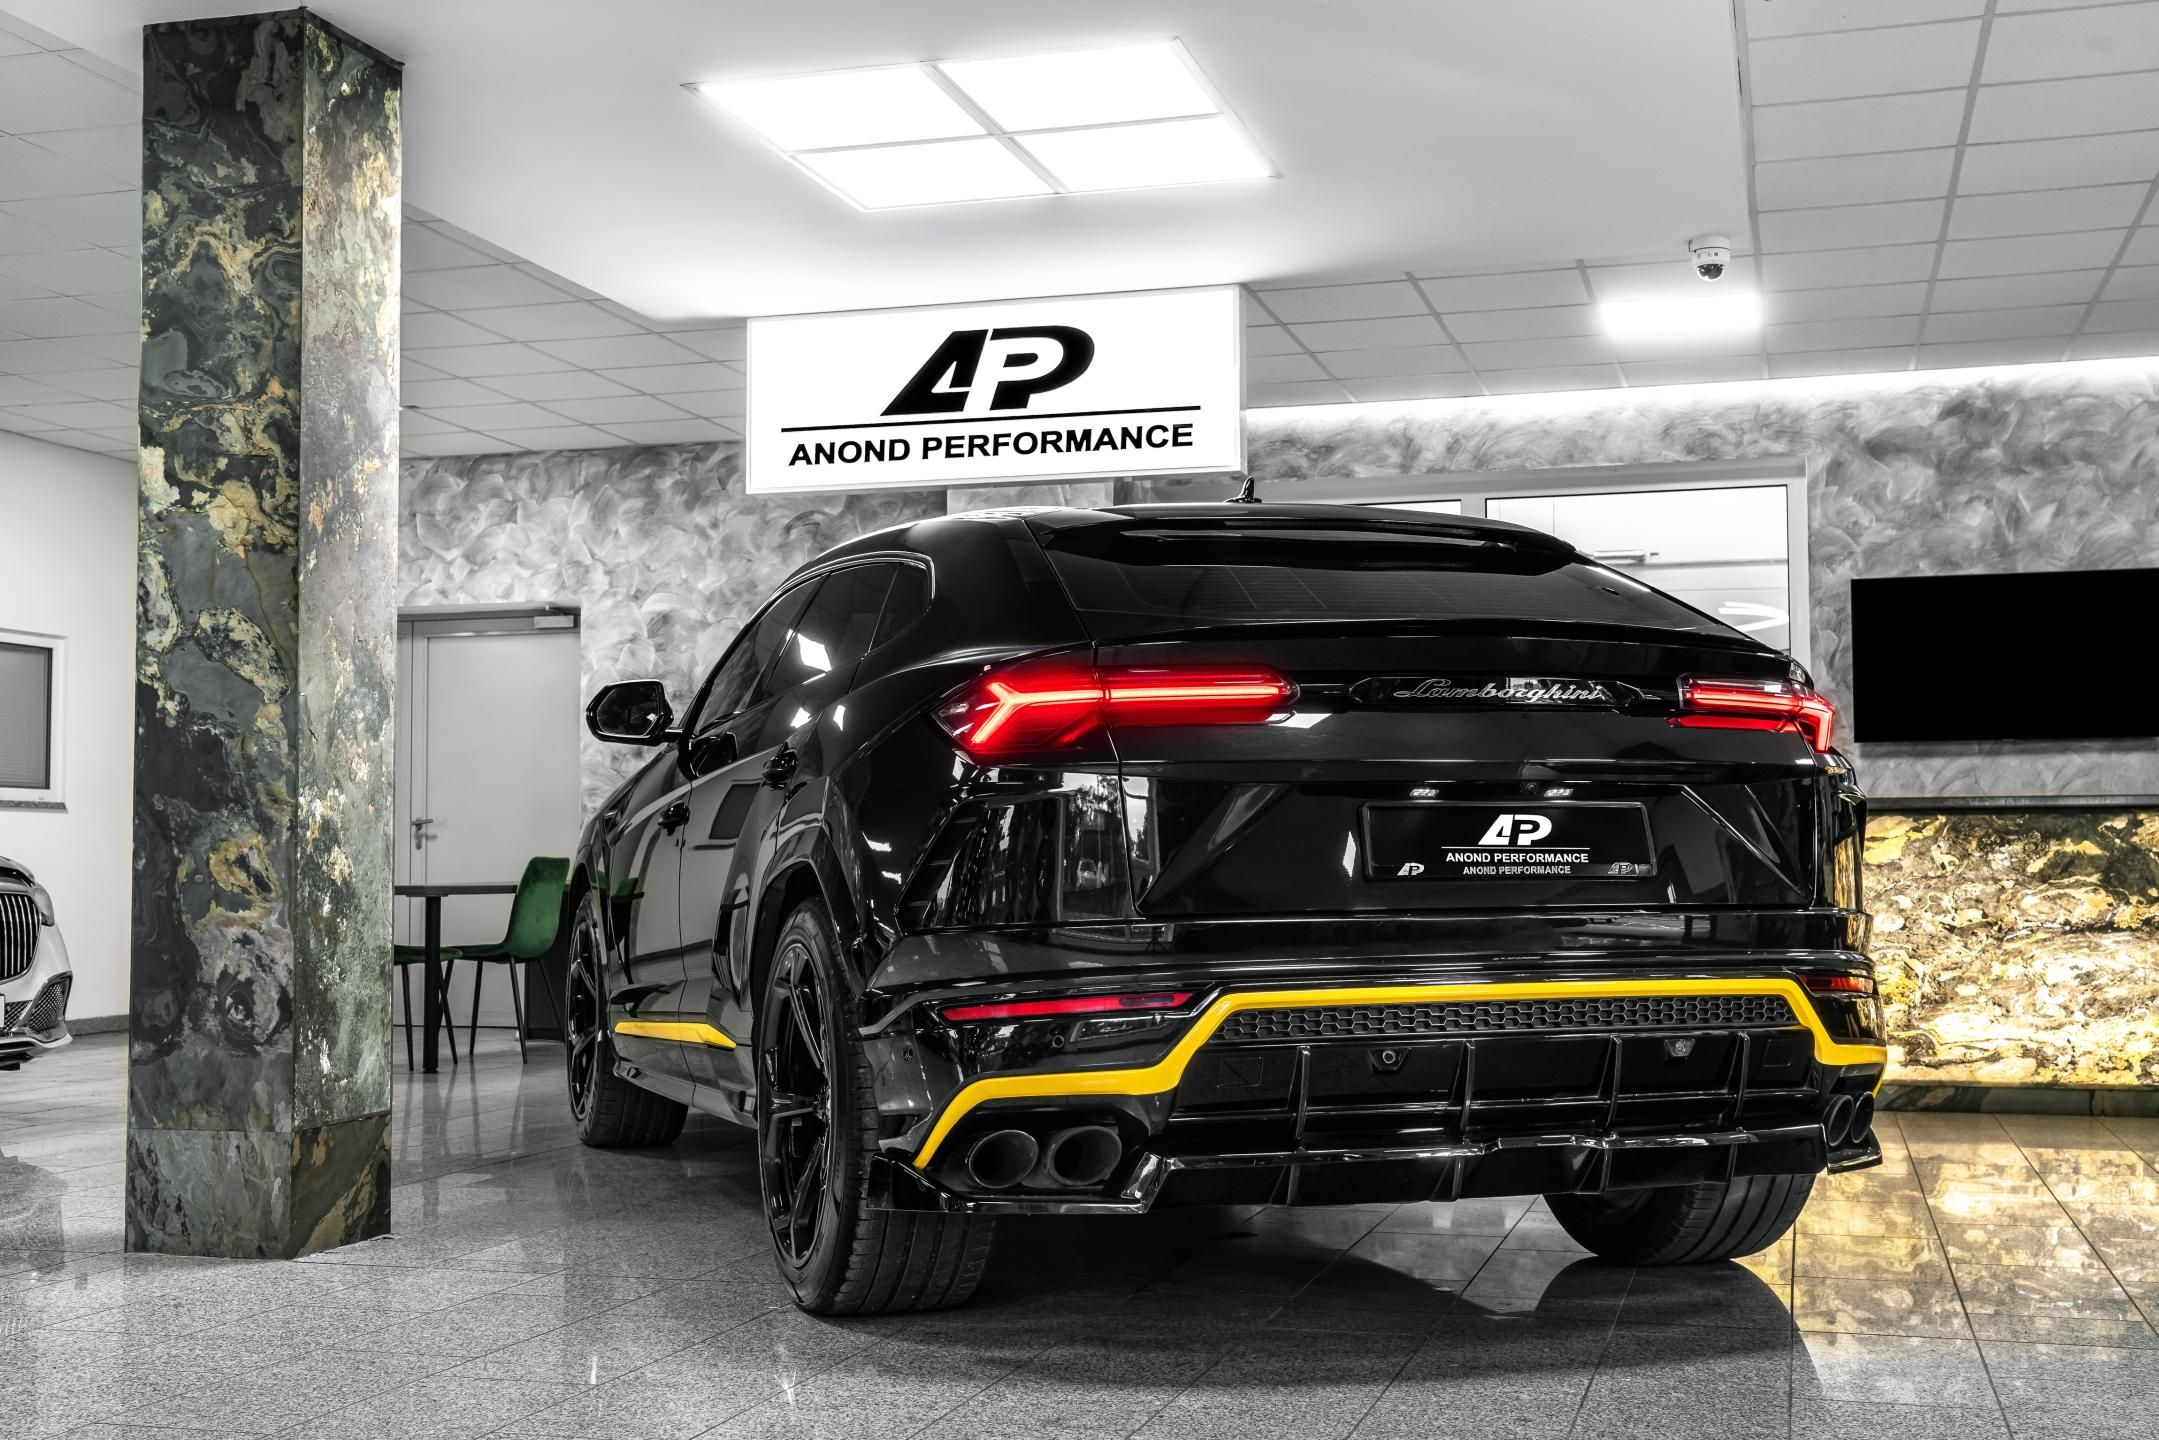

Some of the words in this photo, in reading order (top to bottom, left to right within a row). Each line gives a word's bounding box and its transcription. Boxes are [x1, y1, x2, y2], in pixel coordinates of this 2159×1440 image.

[880, 326, 1094, 416] AP
[789, 439, 910, 466] ANOND
[923, 424, 1192, 459] PERFORMANCE
[1394, 678, 1606, 702] Lamborghini
[1477, 814, 1553, 846] AP
[1446, 852, 1491, 862] ANOND
[1494, 853, 1589, 863] PERFORMANCE
[1396, 862, 1425, 876] AP
[1463, 866, 1497, 875] ANOND
[1499, 865, 1572, 875] PERFORMANCE
[1607, 861, 1634, 875] AP
